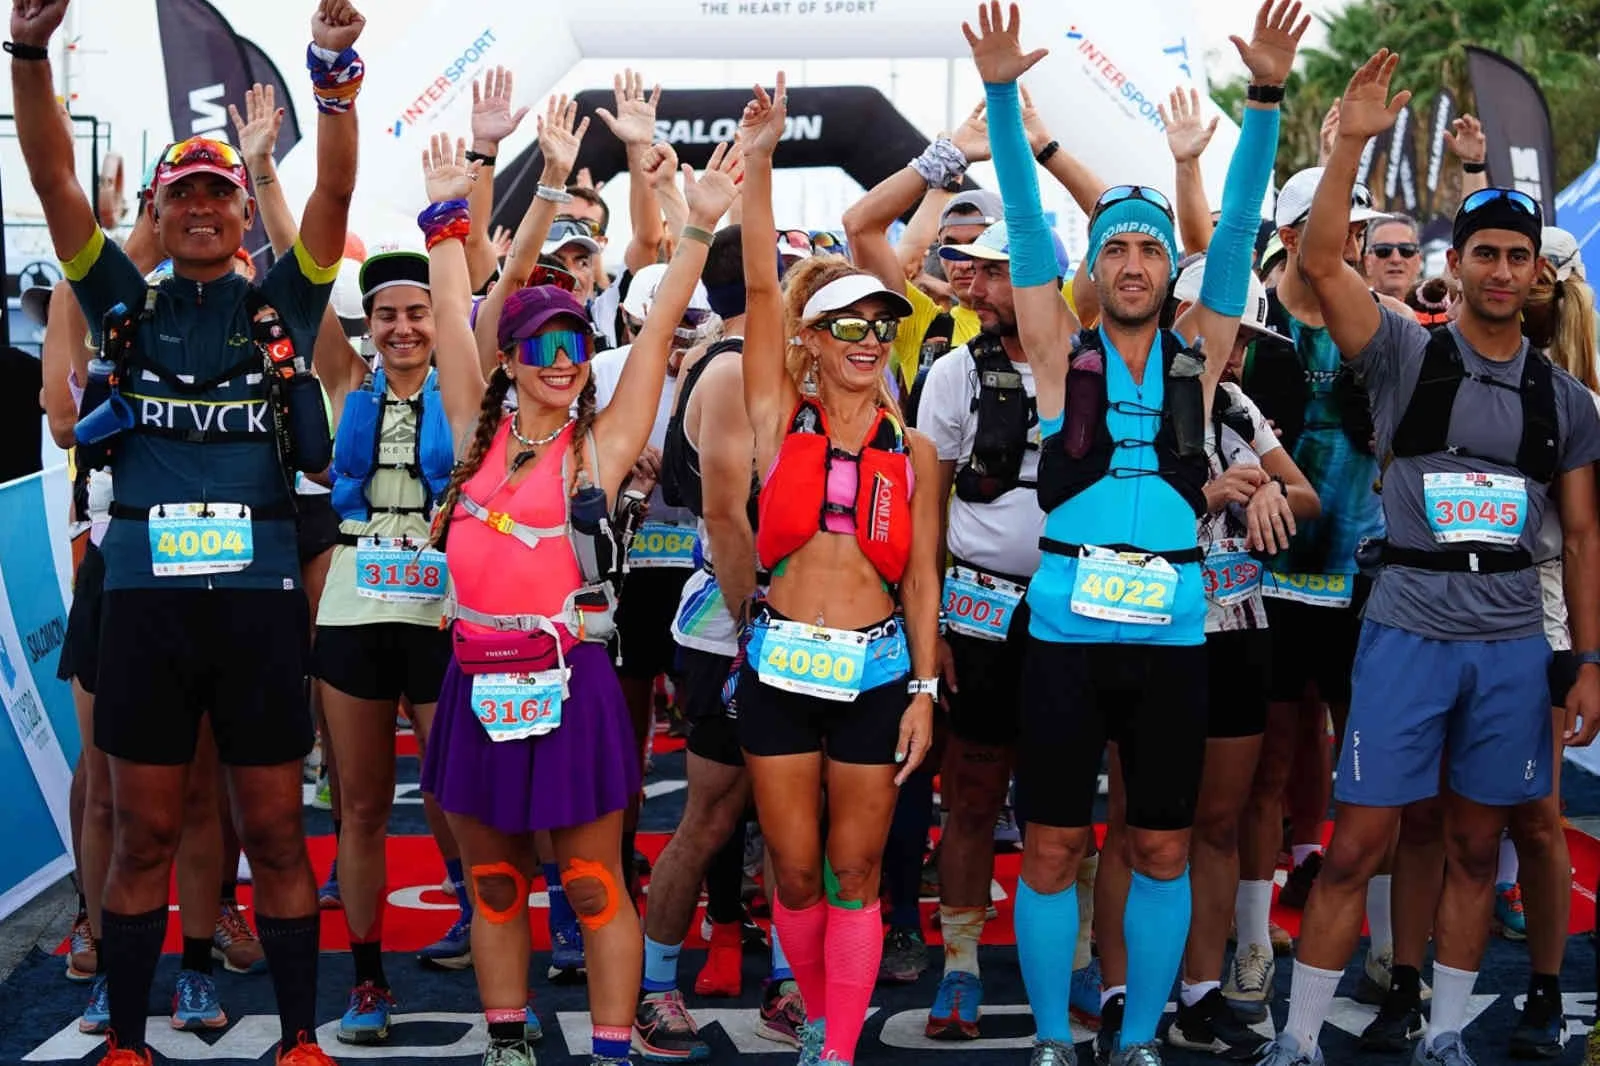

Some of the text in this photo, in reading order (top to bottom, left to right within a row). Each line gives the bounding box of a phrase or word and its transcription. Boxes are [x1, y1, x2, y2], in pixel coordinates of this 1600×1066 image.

[701, 1, 877, 15] THE HEART OF SPORT
[401, 28, 498, 125] INTERSPORT
[653, 115, 823, 145] SALOON
[1436, 500, 1518, 527] 3045
[157, 530, 244, 557] 4004
[631, 533, 694, 553] 4064
[365, 563, 439, 588] 3158
[1082, 573, 1166, 608] 4022
[946, 591, 1005, 627] 3001
[767, 646, 855, 682] 4090
[480, 697, 553, 724] 3161
